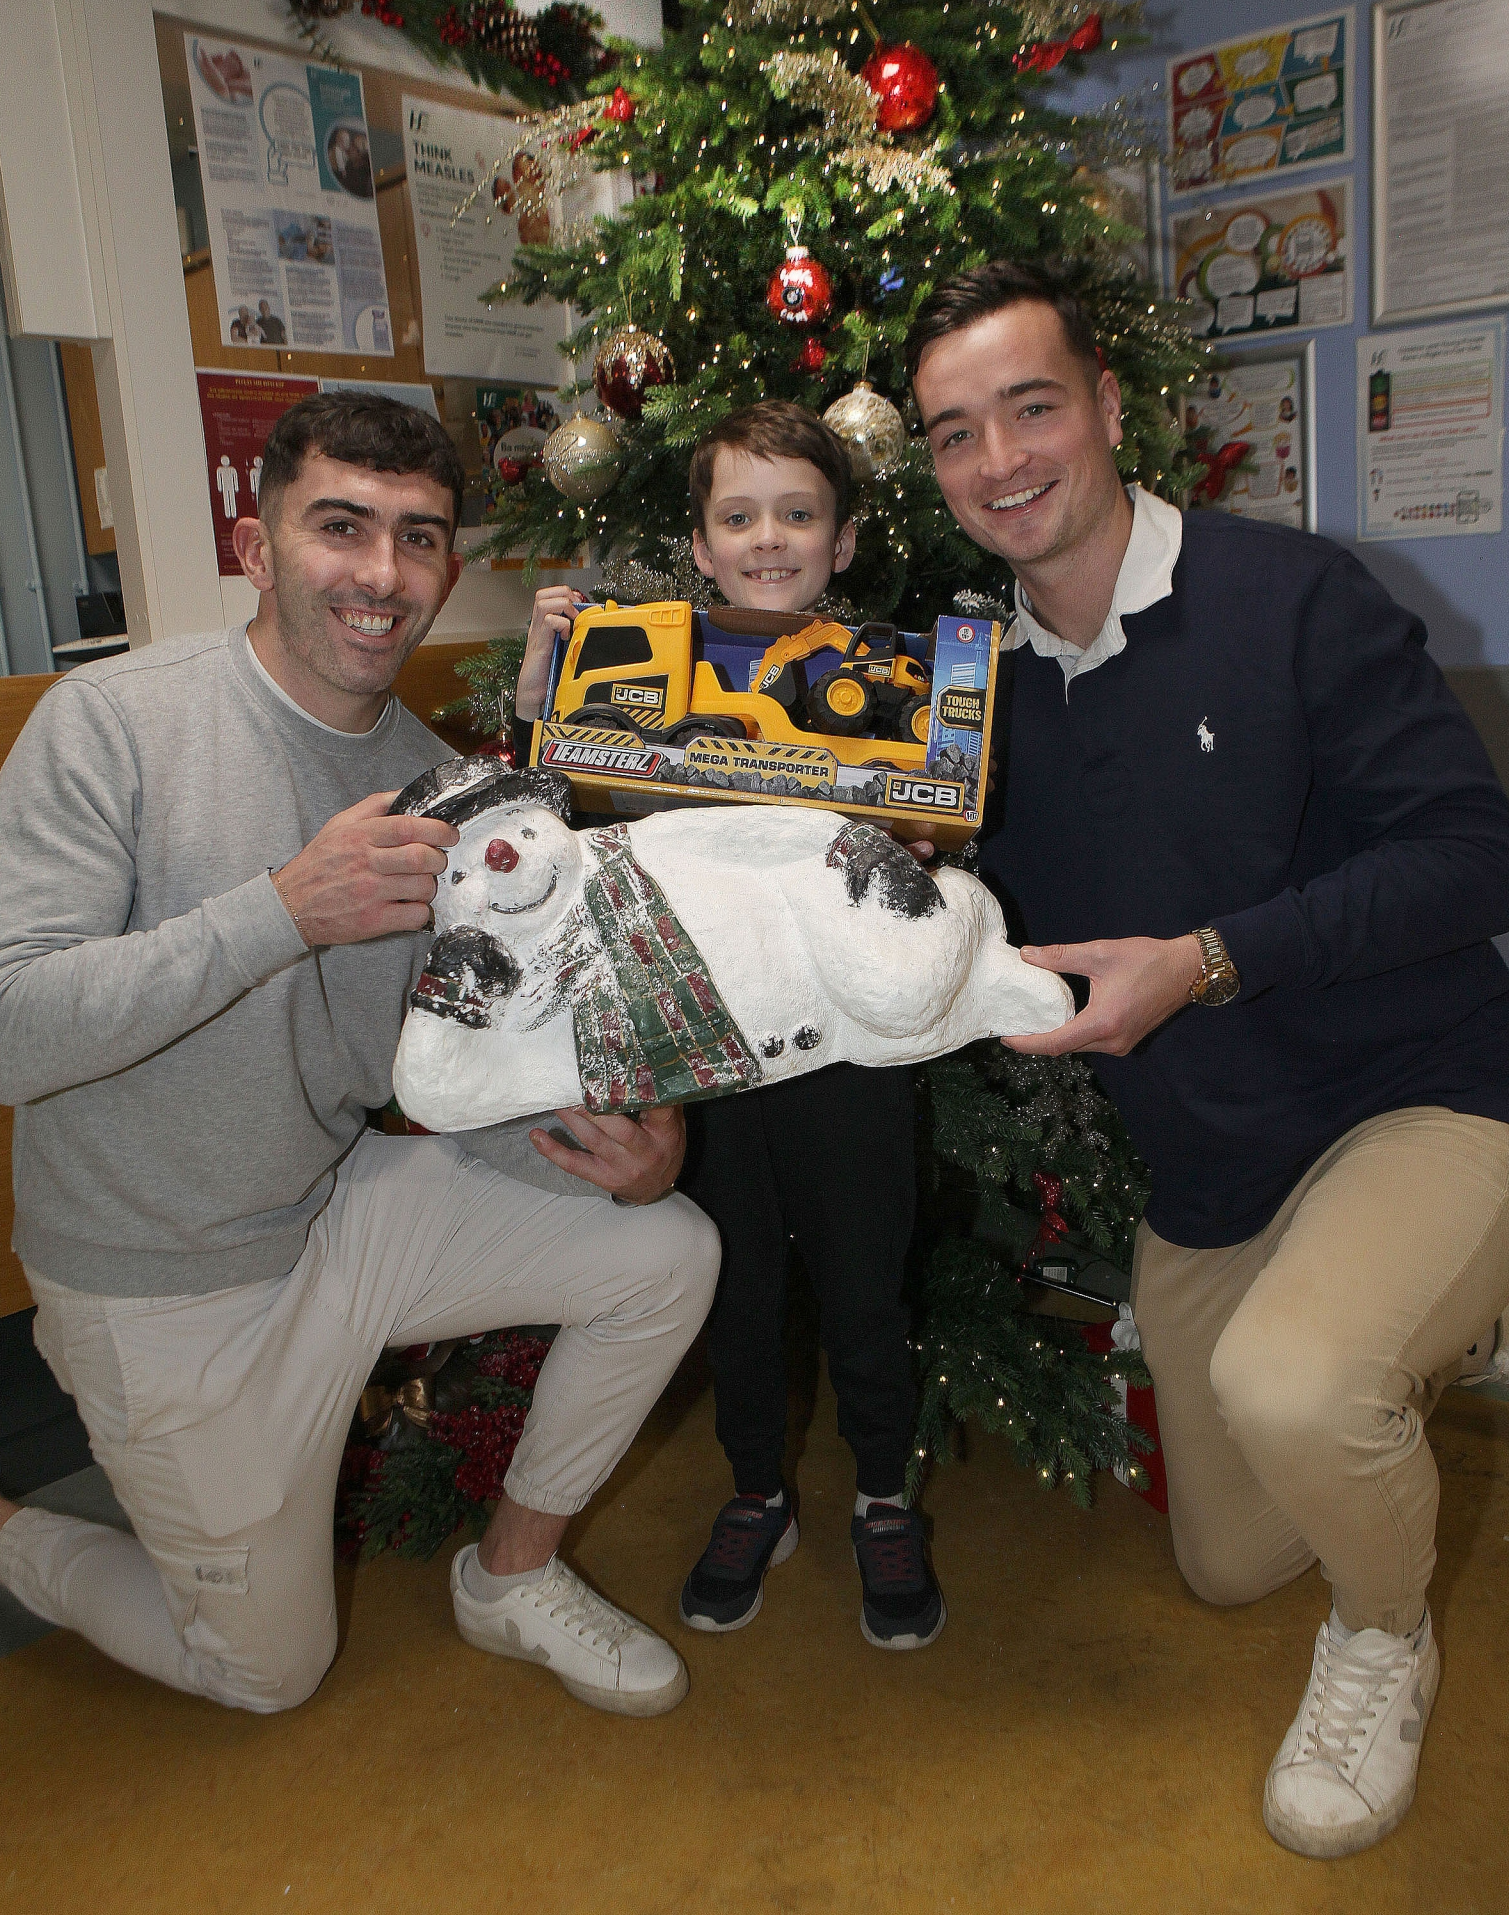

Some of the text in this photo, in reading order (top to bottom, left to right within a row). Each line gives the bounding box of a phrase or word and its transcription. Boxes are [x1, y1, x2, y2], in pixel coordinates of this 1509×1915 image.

[414, 140, 452, 161] THINK
[414, 159, 475, 184] MEASLES
[763, 665, 780, 690] JCB
[615, 688, 659, 703] JCB
[945, 694, 980, 709] TOUGH
[942, 705, 982, 721] TRUCKS
[551, 740, 653, 772] TEAMSTERZ
[689, 752, 829, 777] MEGA TRANSPORTER
[892, 782, 957, 806] JCB
